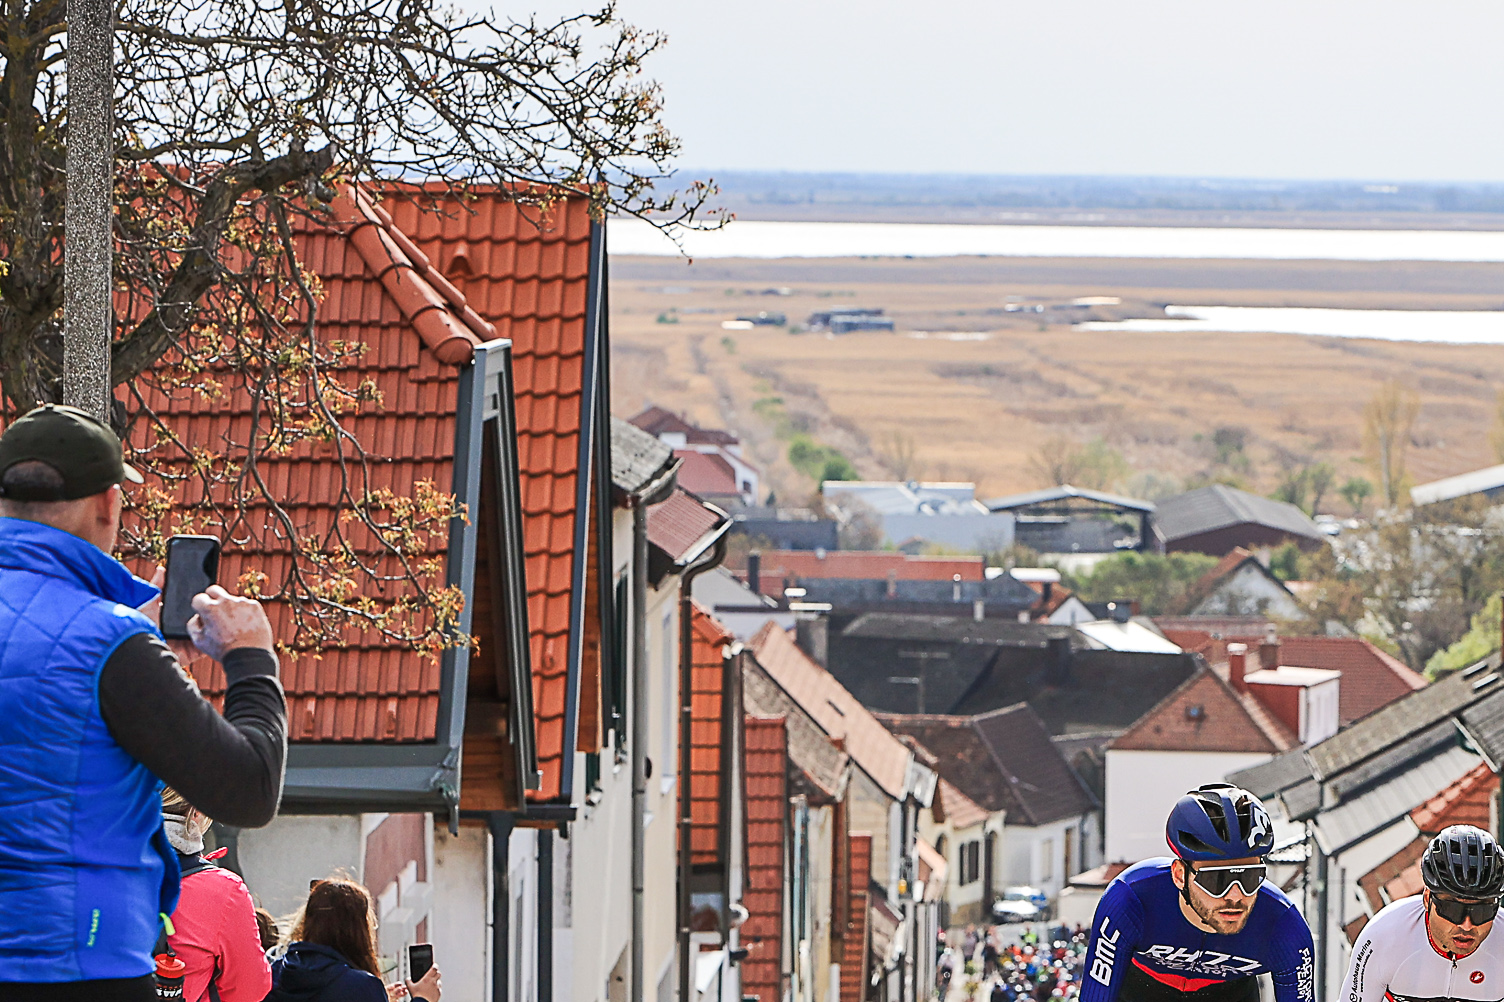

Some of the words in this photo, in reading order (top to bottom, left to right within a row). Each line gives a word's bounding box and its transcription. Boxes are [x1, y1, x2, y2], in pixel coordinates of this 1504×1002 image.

[1089, 916, 1120, 987] BMC
[1137, 944, 1262, 972] RH77
[1356, 939, 1372, 963] Marina
[1351, 962, 1362, 993] Autohaus
